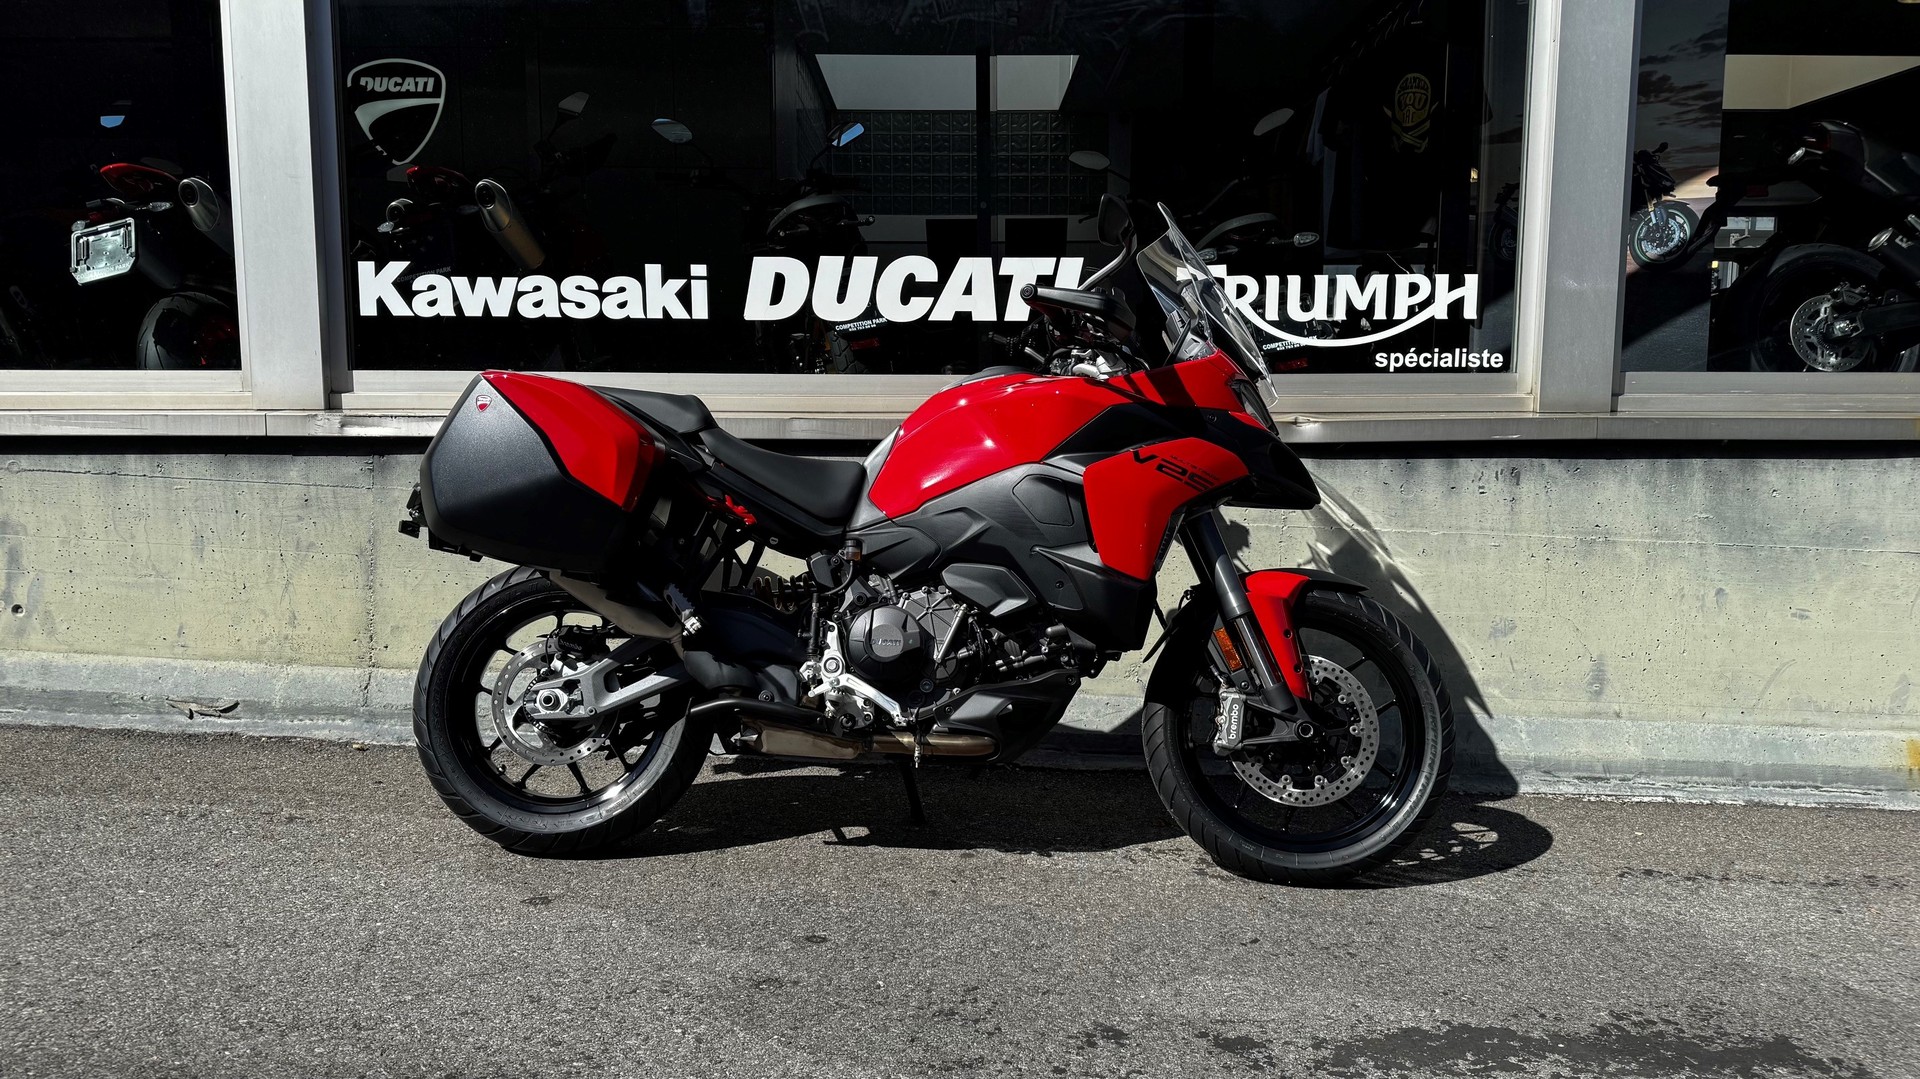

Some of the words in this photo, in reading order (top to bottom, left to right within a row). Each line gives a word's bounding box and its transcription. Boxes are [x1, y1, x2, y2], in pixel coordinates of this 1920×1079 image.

[360, 77, 435, 92] DUCATI
[436, 266, 452, 274] PARK
[357, 261, 709, 319] Kawasaki
[743, 255, 1084, 322] DUCATI
[1177, 264, 1479, 346] TRIUMPH
[835, 319, 872, 331] COMPETITION
[872, 317, 888, 325] PARK
[1375, 348, 1504, 372] spécialiste
[871, 638, 902, 646] DUCATI
[1228, 703, 1239, 740] brembo
